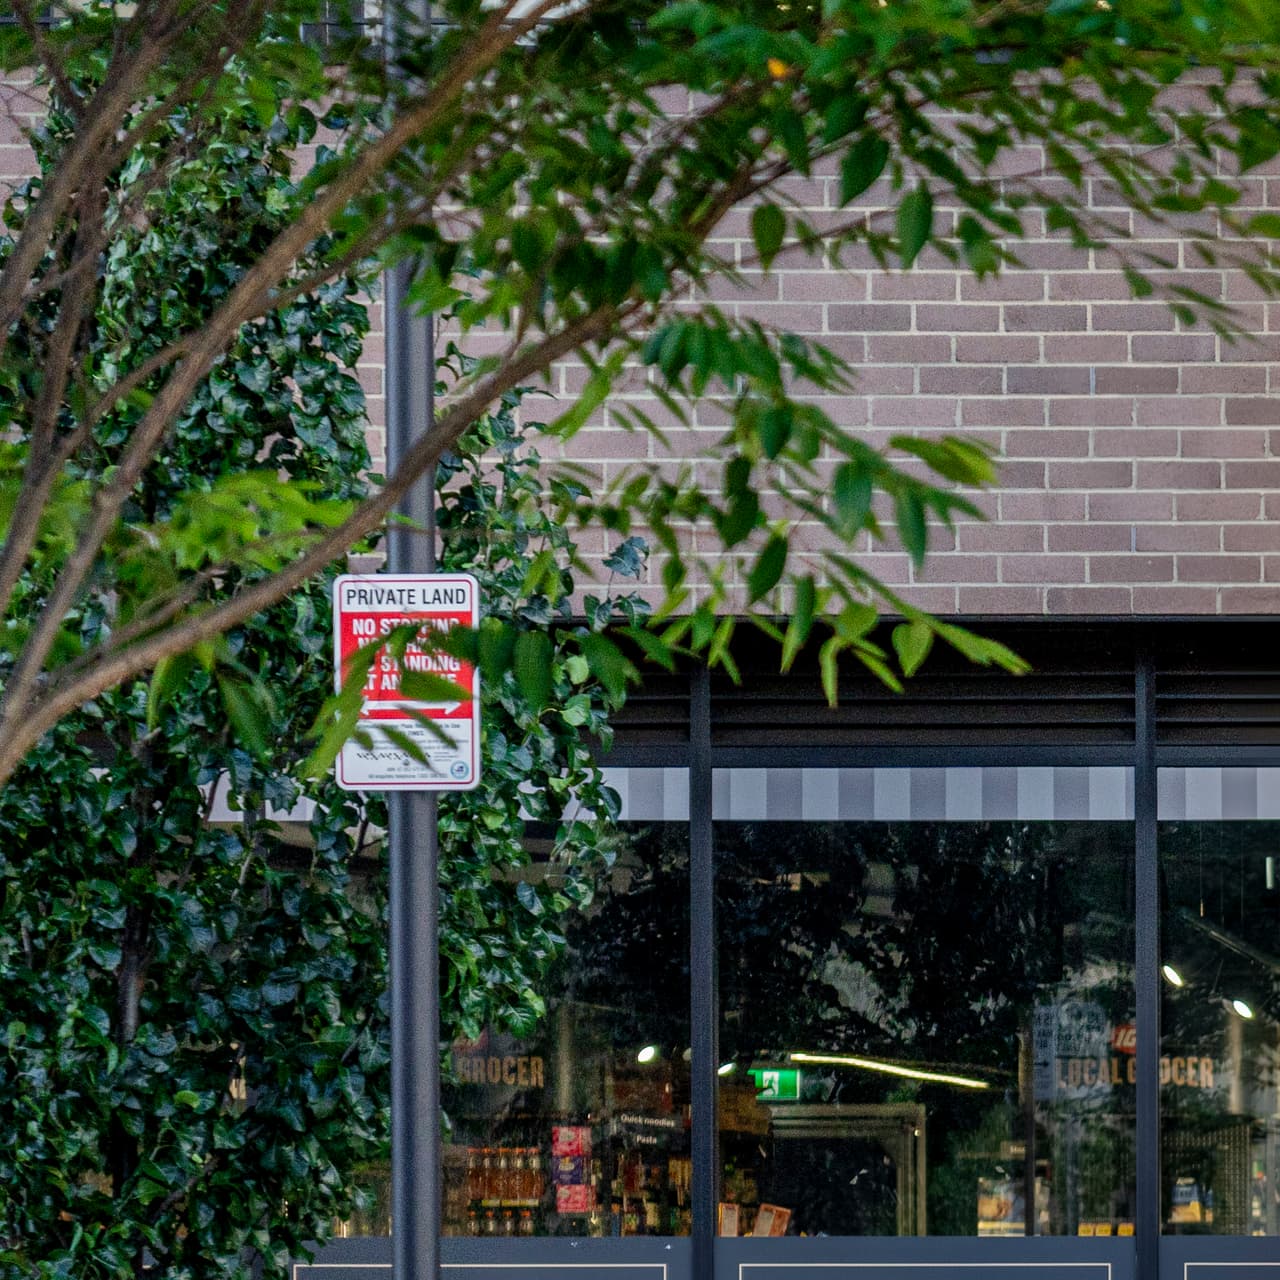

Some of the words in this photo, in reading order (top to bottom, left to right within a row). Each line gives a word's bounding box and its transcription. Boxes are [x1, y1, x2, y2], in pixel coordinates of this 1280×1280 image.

[346, 588, 416, 605] PRIVATE
[422, 588, 466, 605] LAND
[352, 618, 376, 635] NO
[1116, 1028, 1136, 1048] IG
[1127, 1055, 1214, 1089] GOCER
